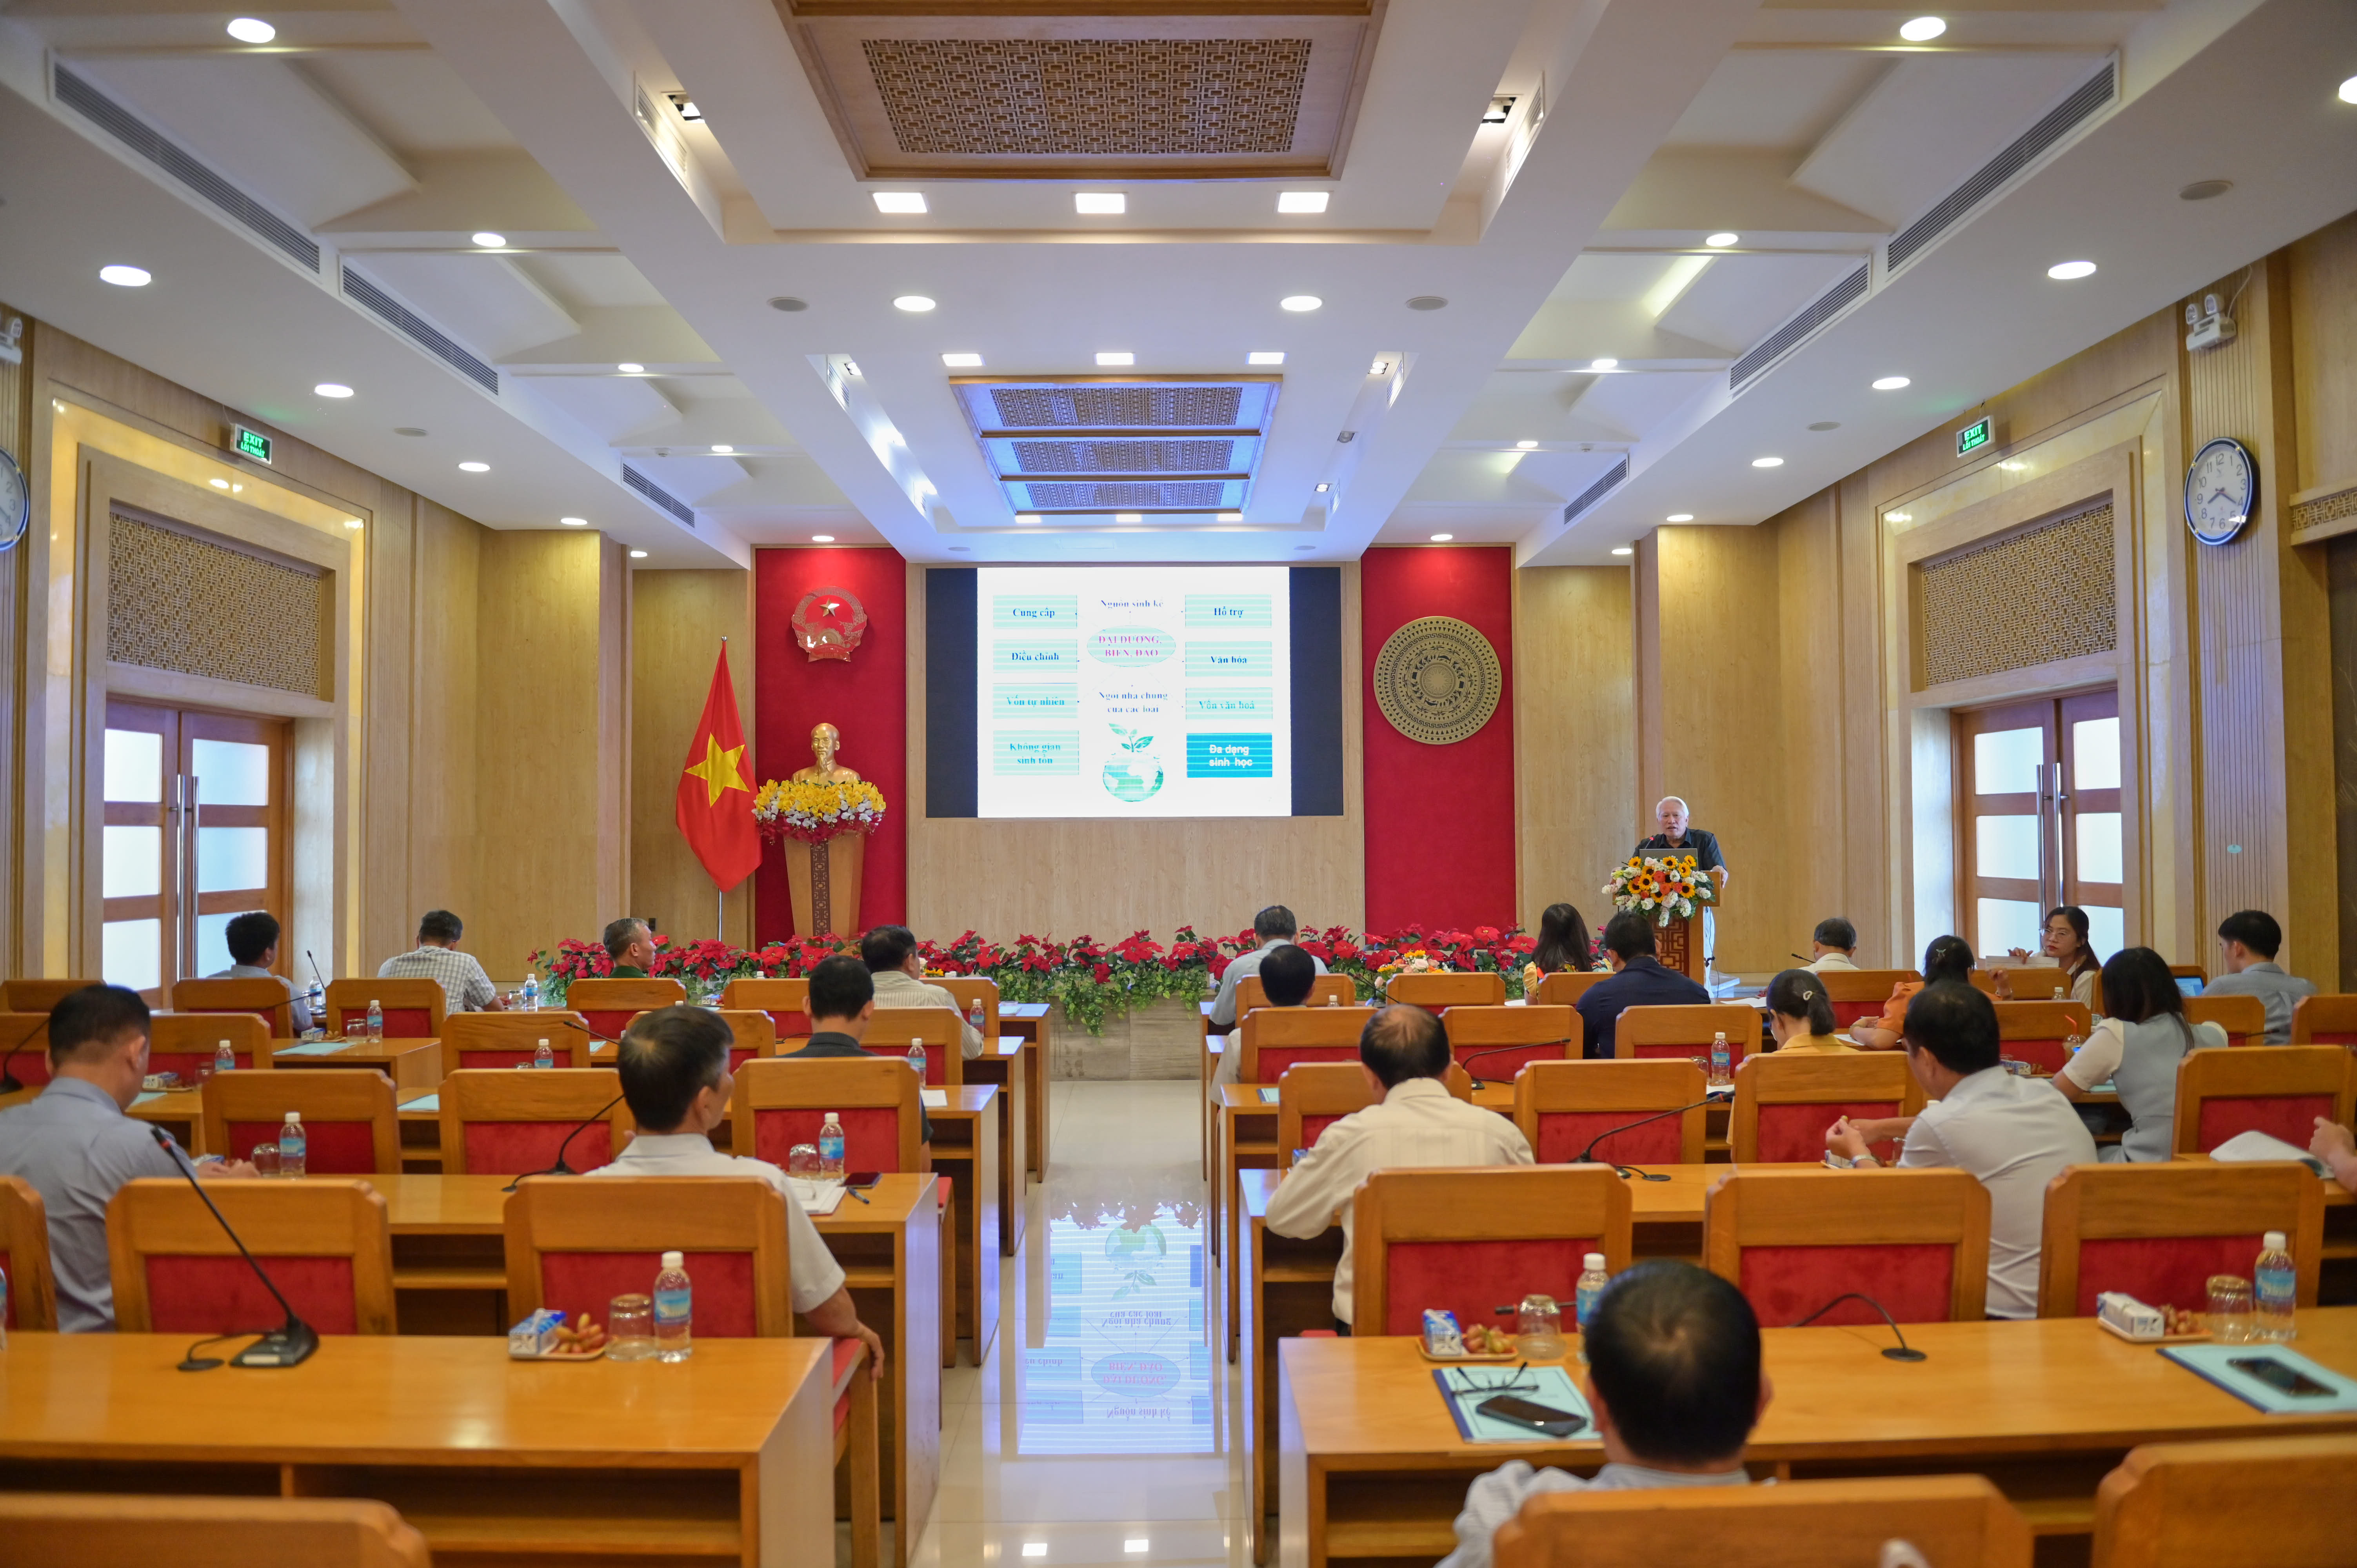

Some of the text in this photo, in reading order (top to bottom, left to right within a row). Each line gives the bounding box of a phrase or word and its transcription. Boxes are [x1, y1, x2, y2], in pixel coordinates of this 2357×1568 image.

[1964, 424, 1983, 441] EXIT
[244, 431, 264, 447] EXIT
[1971, 434, 1985, 446] THOÁT
[249, 445, 265, 458] THOÁT
[2216, 453, 2224, 466] 12
[2230, 455, 2233, 466] 1
[2206, 461, 2212, 474] 11
[2237, 464, 2242, 476] 2
[2198, 476, 2206, 489] 10
[2241, 479, 2246, 491] 3
[9, 498, 16, 511] 3
[2197, 493, 2203, 505] 9
[2238, 496, 2244, 507] 4
[2201, 508, 2208, 519] 8
[2210, 517, 2215, 529] 7
[2219, 518, 2226, 529] 6
[1013, 608, 1038, 618] Cung
[1229, 609, 1244, 618] trợ
[1012, 650, 1032, 661] Điều
[1232, 655, 1247, 664] hóa
[1141, 692, 1168, 701] chung
[1041, 743, 1061, 753] gian
[1209, 744, 1249, 756] Đa dạng
[1209, 757, 1253, 769] sinh học
